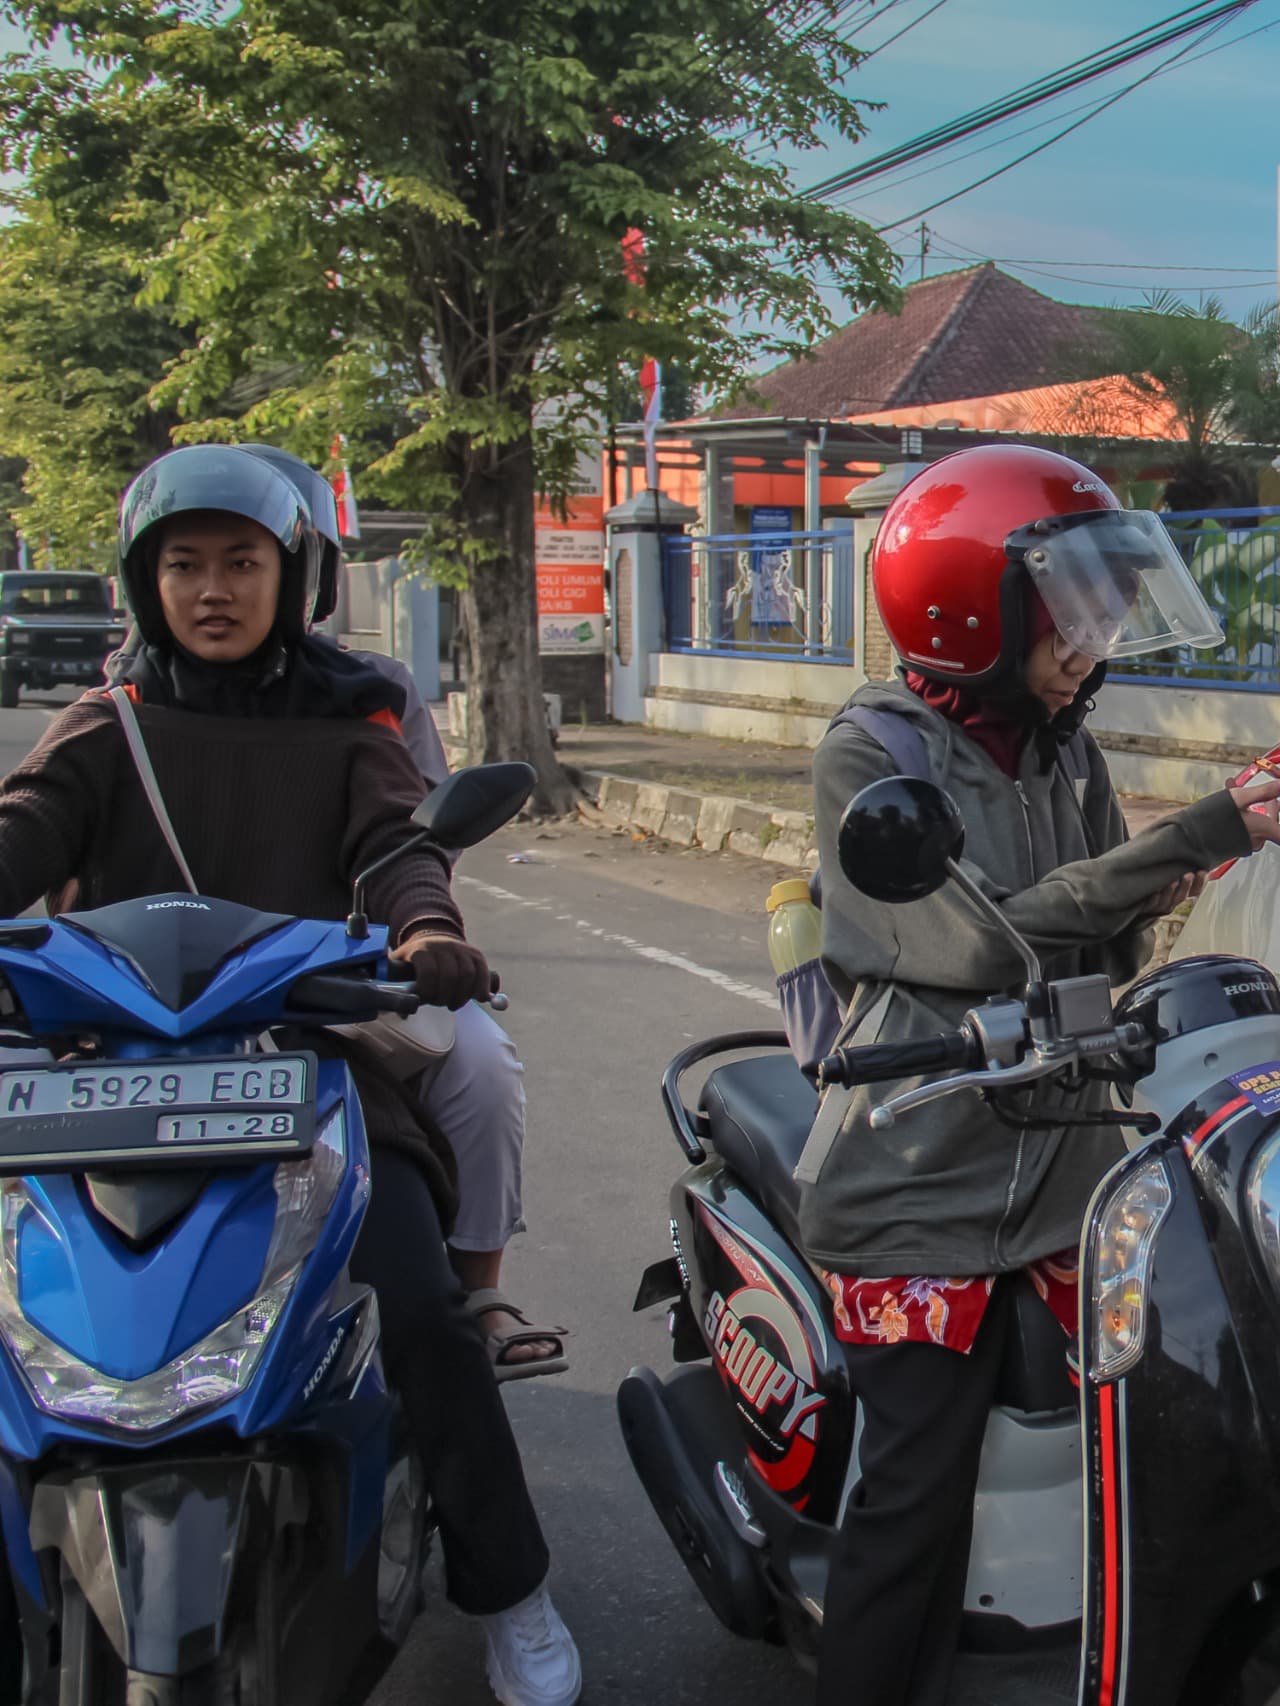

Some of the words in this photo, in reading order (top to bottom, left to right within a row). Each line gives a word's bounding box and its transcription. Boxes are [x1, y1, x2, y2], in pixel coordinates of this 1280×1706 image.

[538, 587, 560, 598] OLI
[145, 900, 212, 912] HONDA
[1223, 980, 1278, 997] HONDA
[8, 1080, 36, 1112] N
[70, 1073, 182, 1109] 5929
[210, 1069, 292, 1103] EGB
[1238, 1074, 1271, 1091] OPS
[303, 1326, 345, 1401] HONDA
[704, 1290, 827, 1436] SCOOPY
